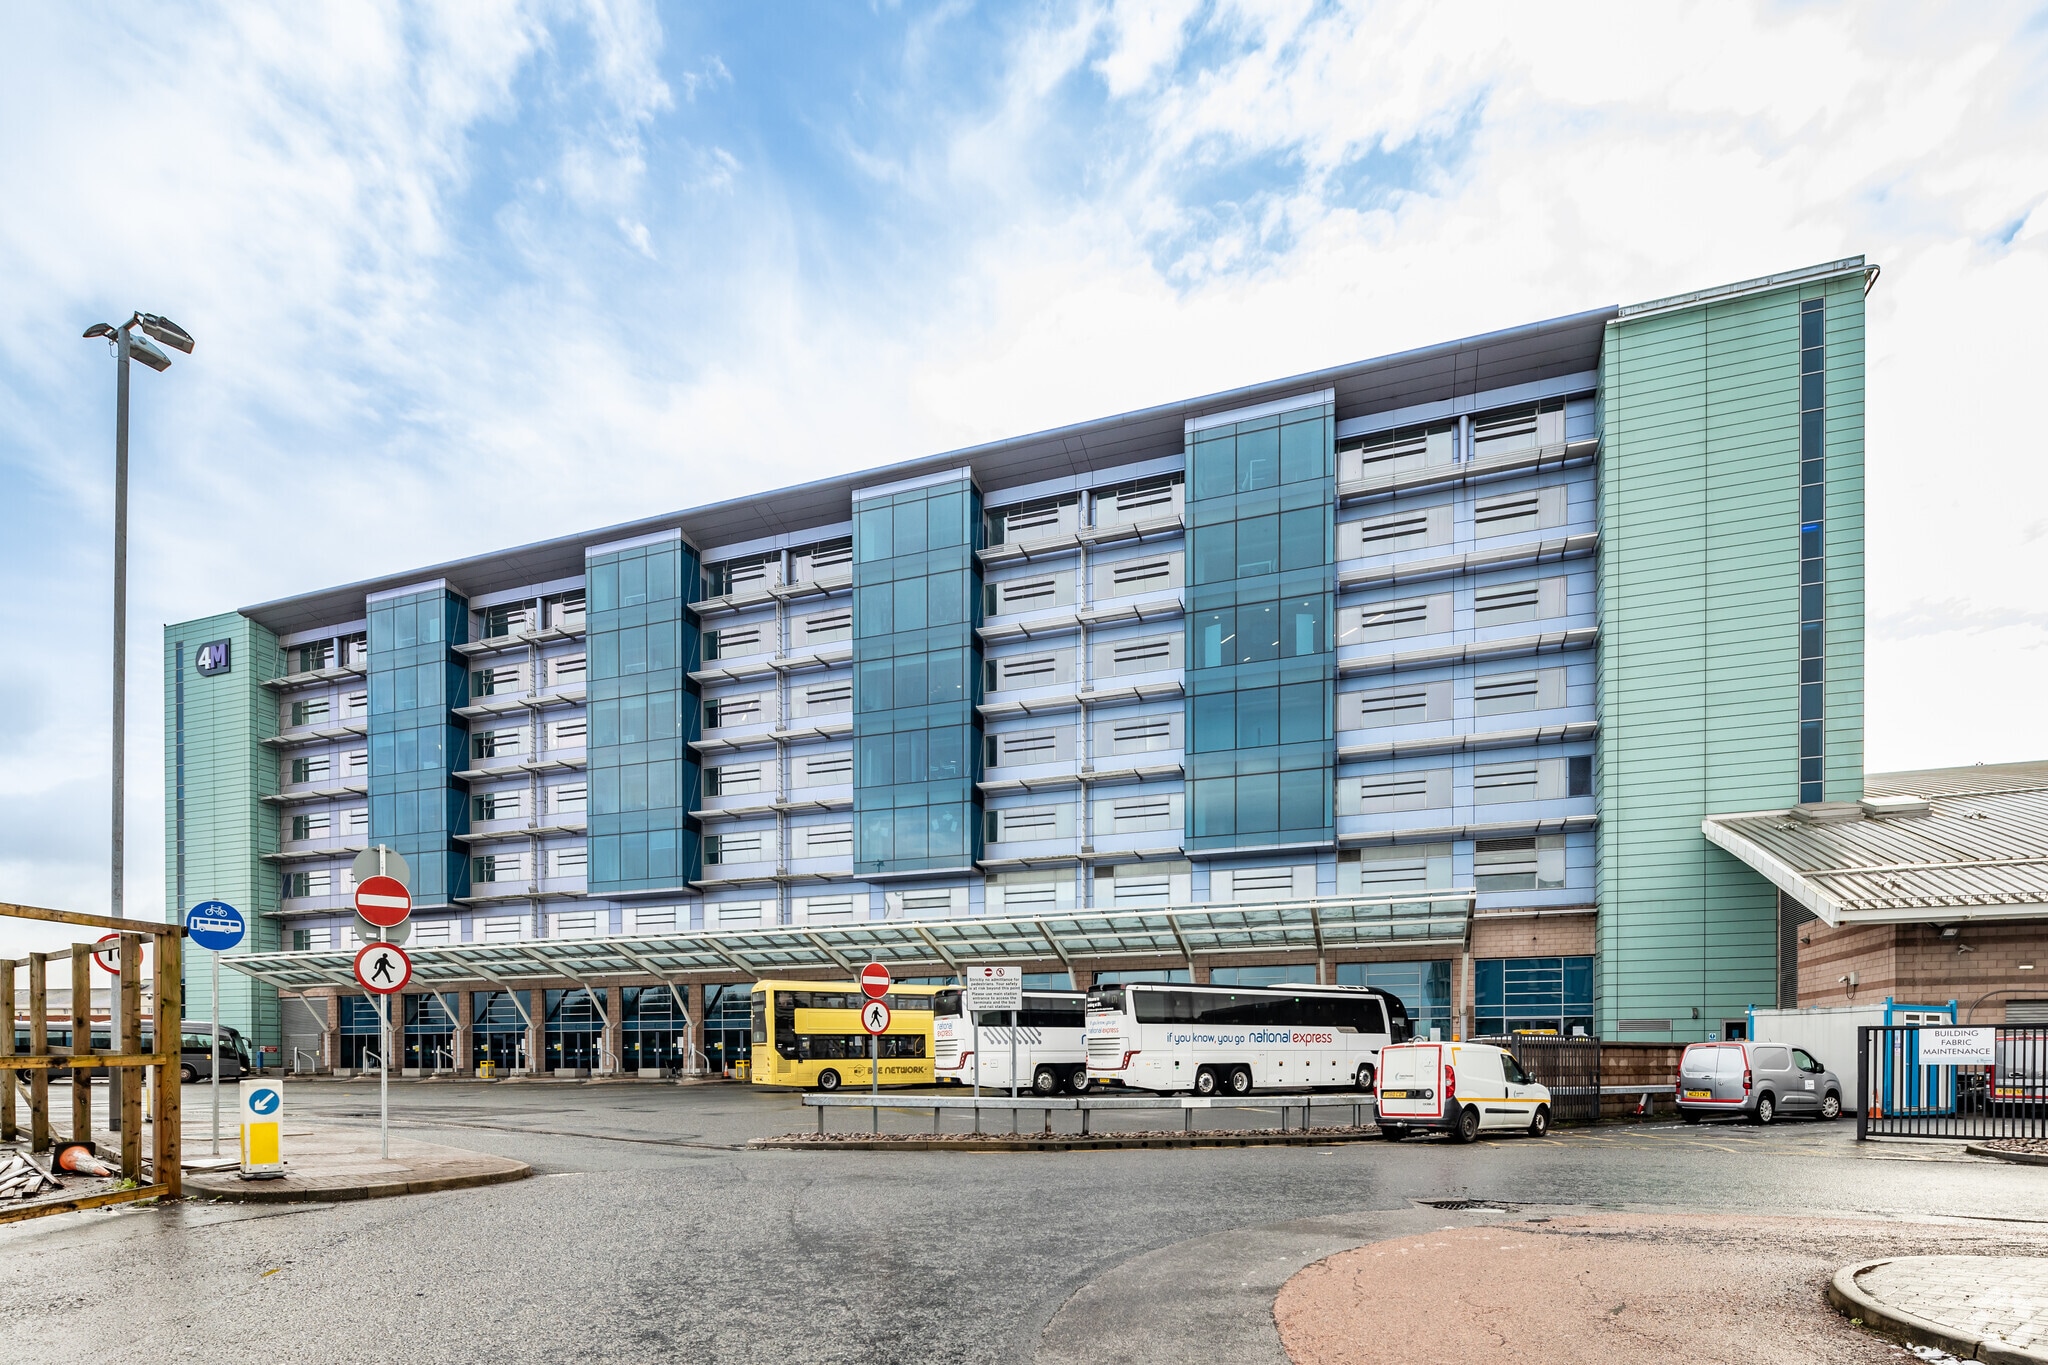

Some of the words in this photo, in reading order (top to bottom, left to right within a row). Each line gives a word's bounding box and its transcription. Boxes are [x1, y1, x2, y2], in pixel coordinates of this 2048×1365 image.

[198, 643, 227, 669] 4M
[1167, 1032, 1173, 1043] if
[1174, 1035, 1191, 1045] you
[1192, 1033, 1216, 1044] know,
[1217, 1035, 1234, 1045] you
[1235, 1036, 1245, 1045] go
[1249, 1029, 1291, 1043] national
[1292, 1033, 1333, 1046] express
[885, 1066, 924, 1074] NETWORK
